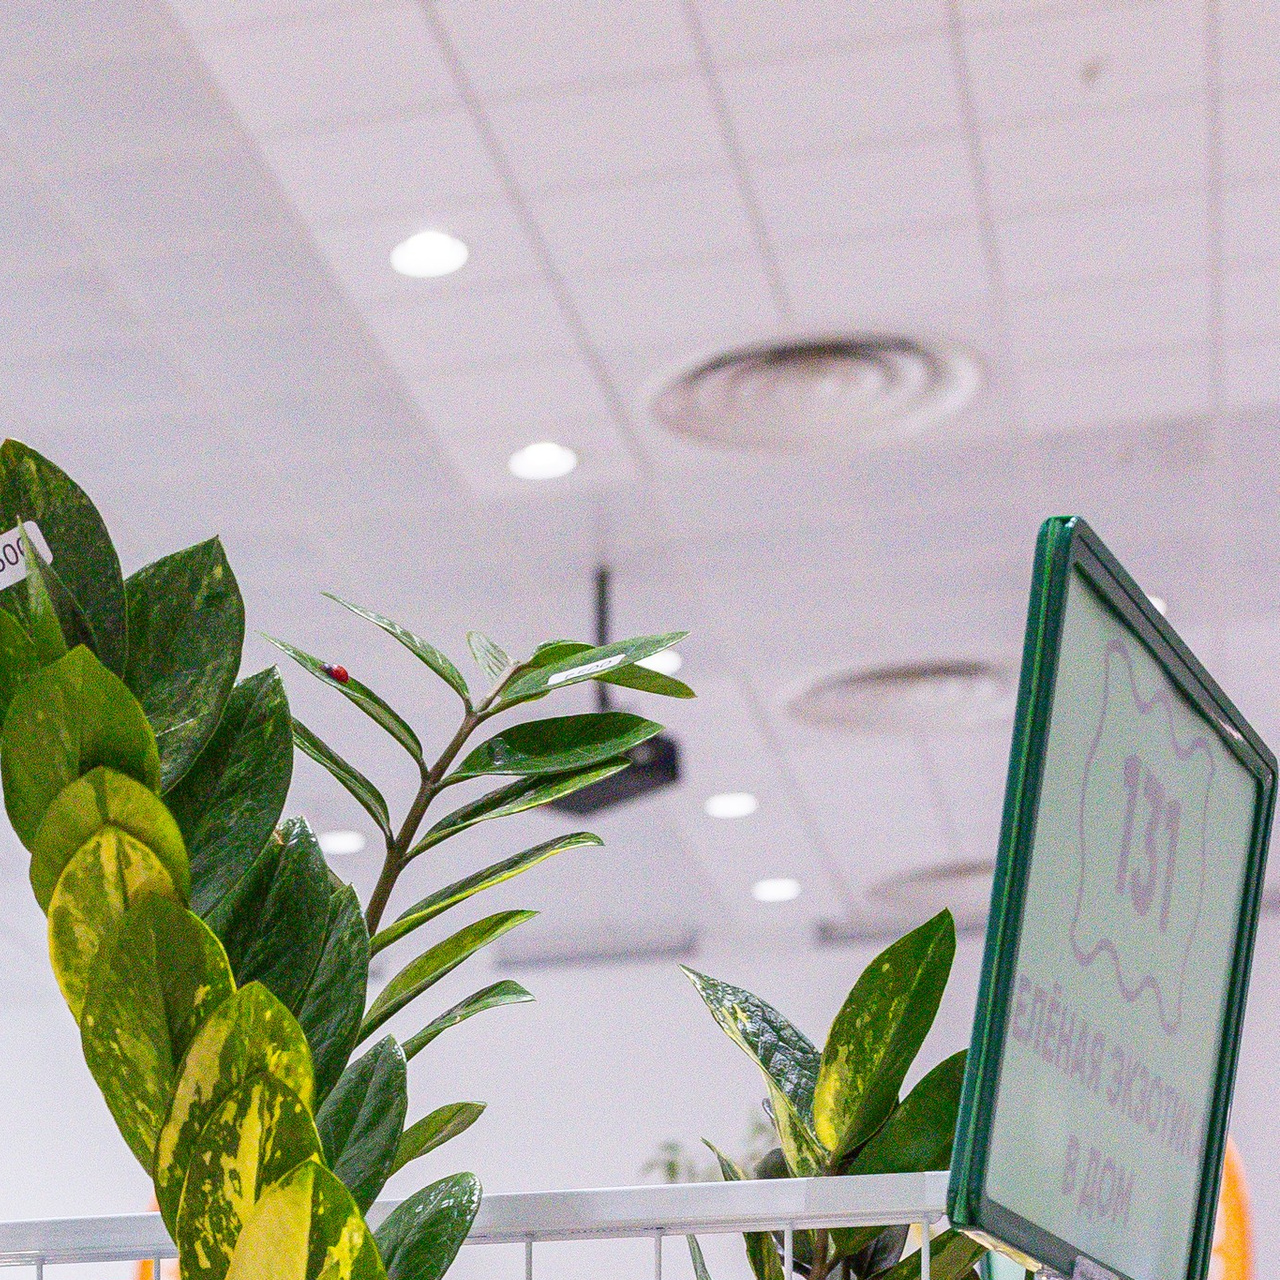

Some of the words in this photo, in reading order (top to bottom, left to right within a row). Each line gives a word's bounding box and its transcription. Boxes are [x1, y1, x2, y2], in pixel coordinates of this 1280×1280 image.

[1115, 754, 1182, 934] 131
[1012, 975, 1106, 1096] ЕЛЁНАЯ
[1061, 1134, 1081, 1196] В
